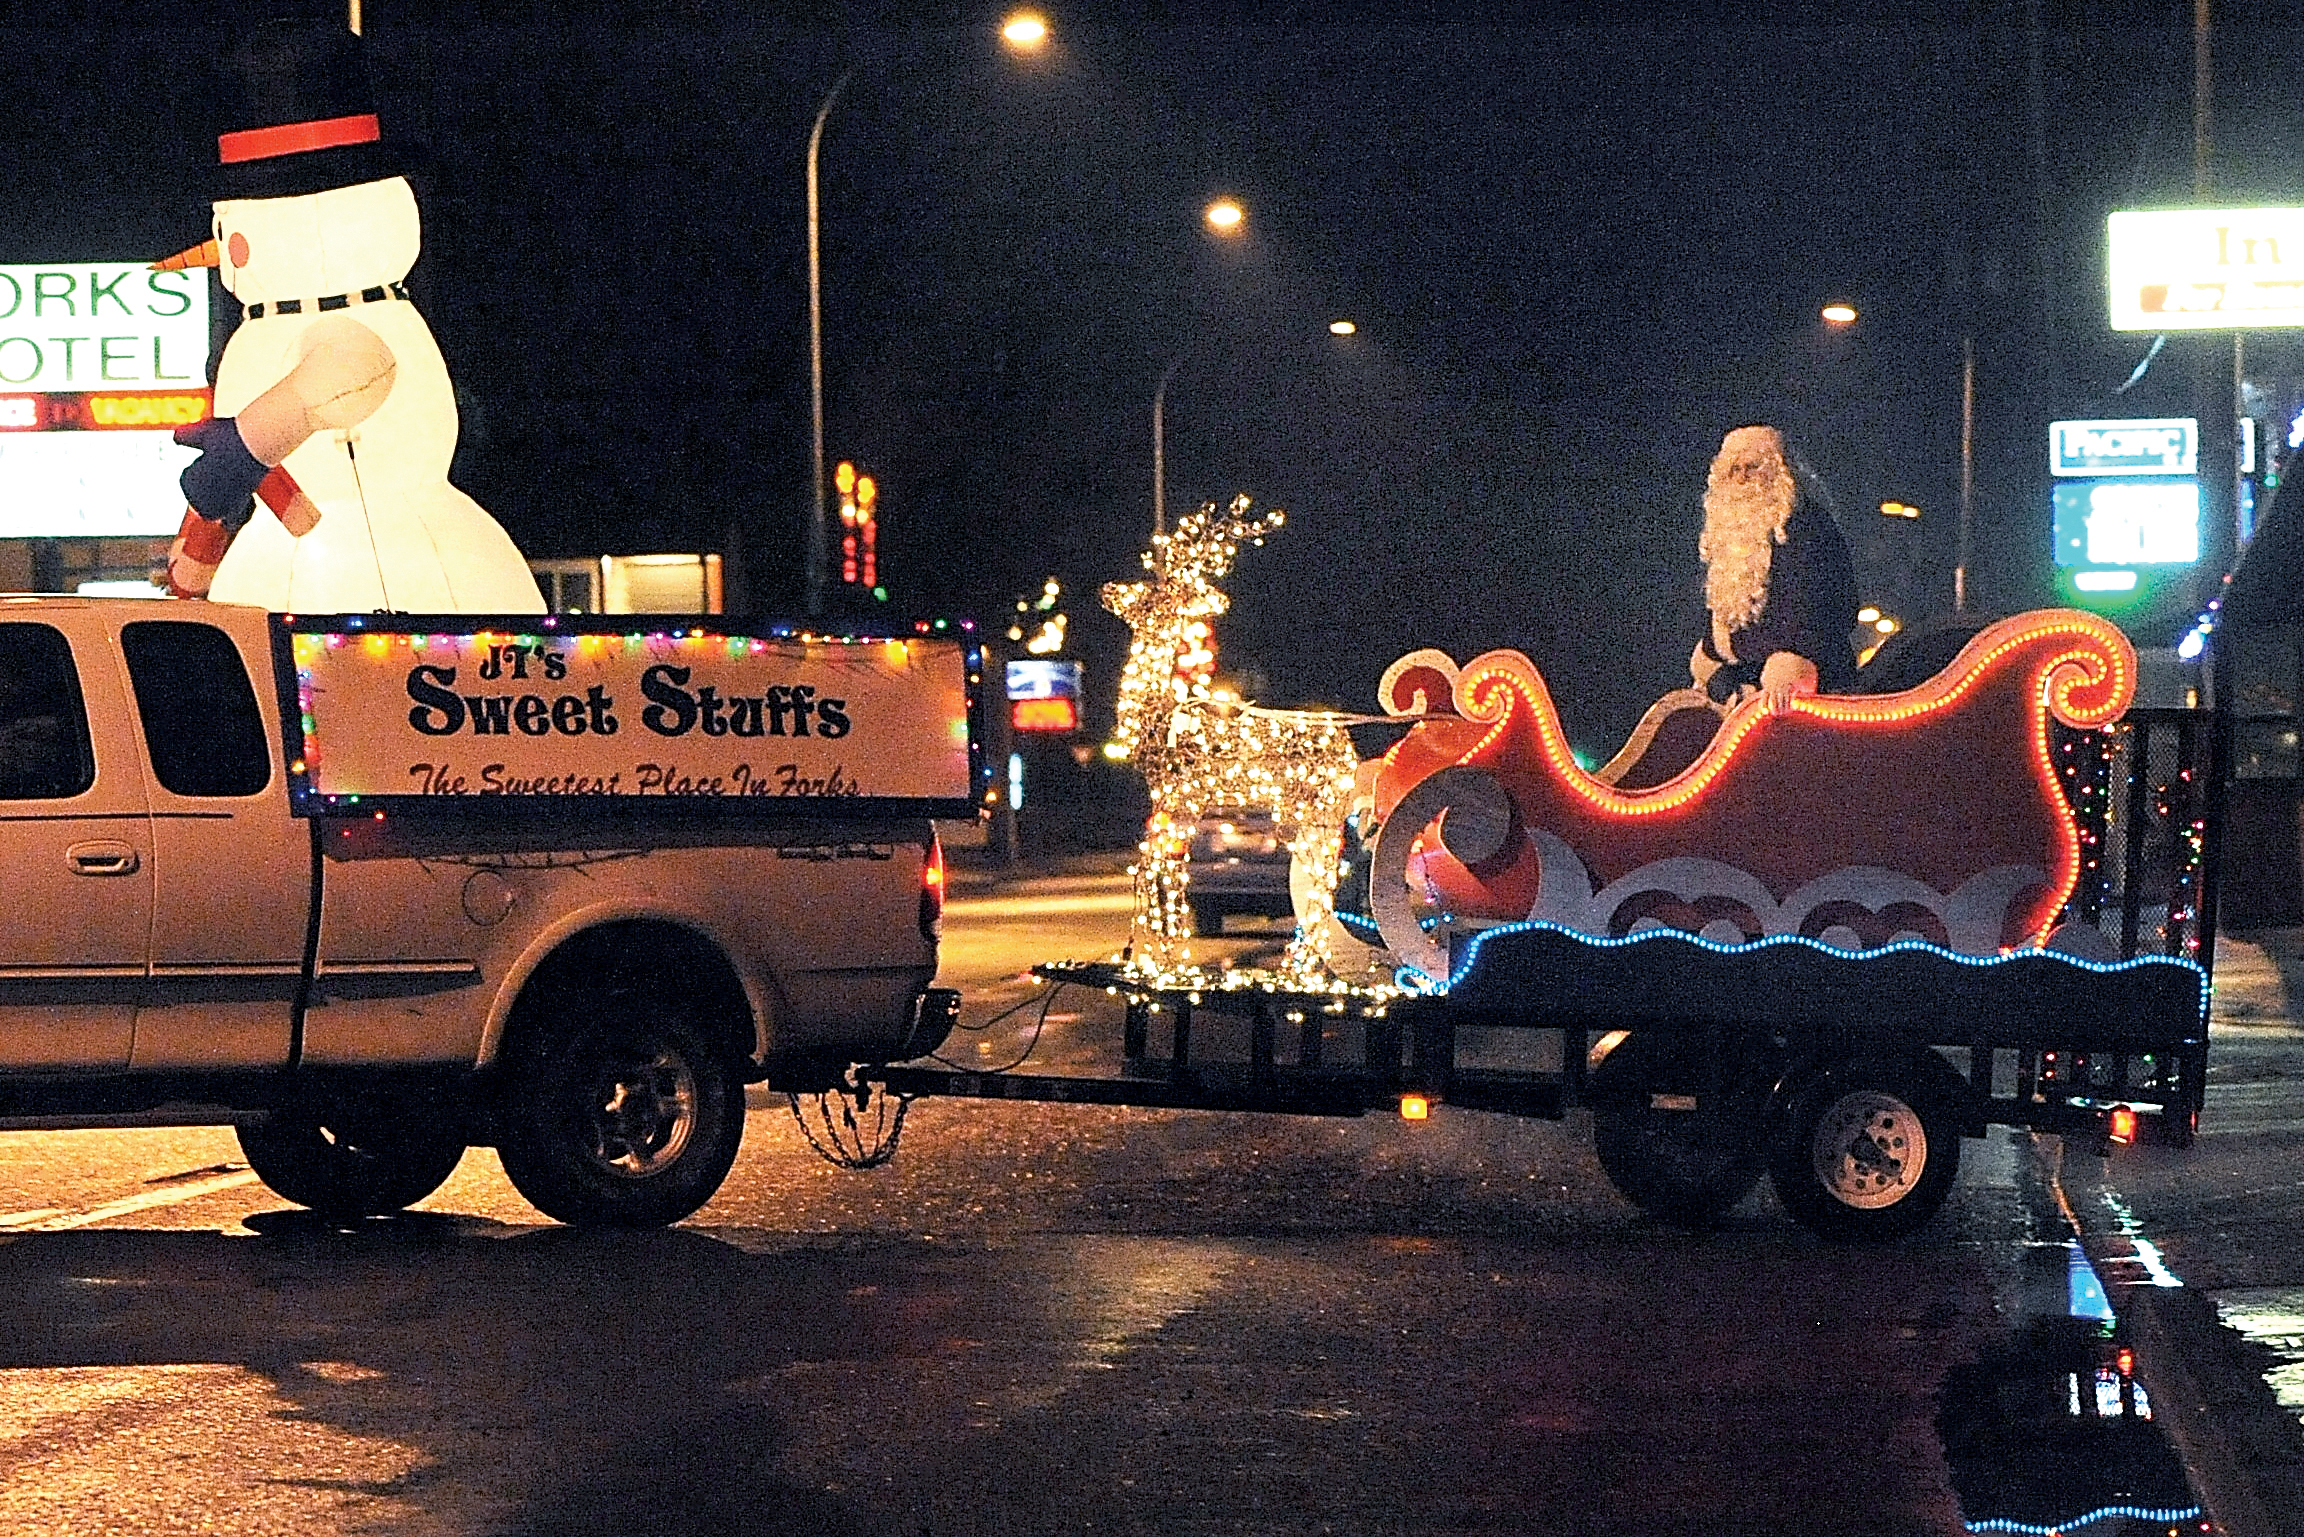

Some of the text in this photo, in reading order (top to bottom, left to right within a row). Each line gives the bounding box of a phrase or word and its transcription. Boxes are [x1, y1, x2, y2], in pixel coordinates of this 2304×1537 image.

[479, 644, 567, 680] JT's
[406, 664, 851, 738] Sweet Stuffs
[409, 763, 860, 797] The Sweetest Place In Forks
